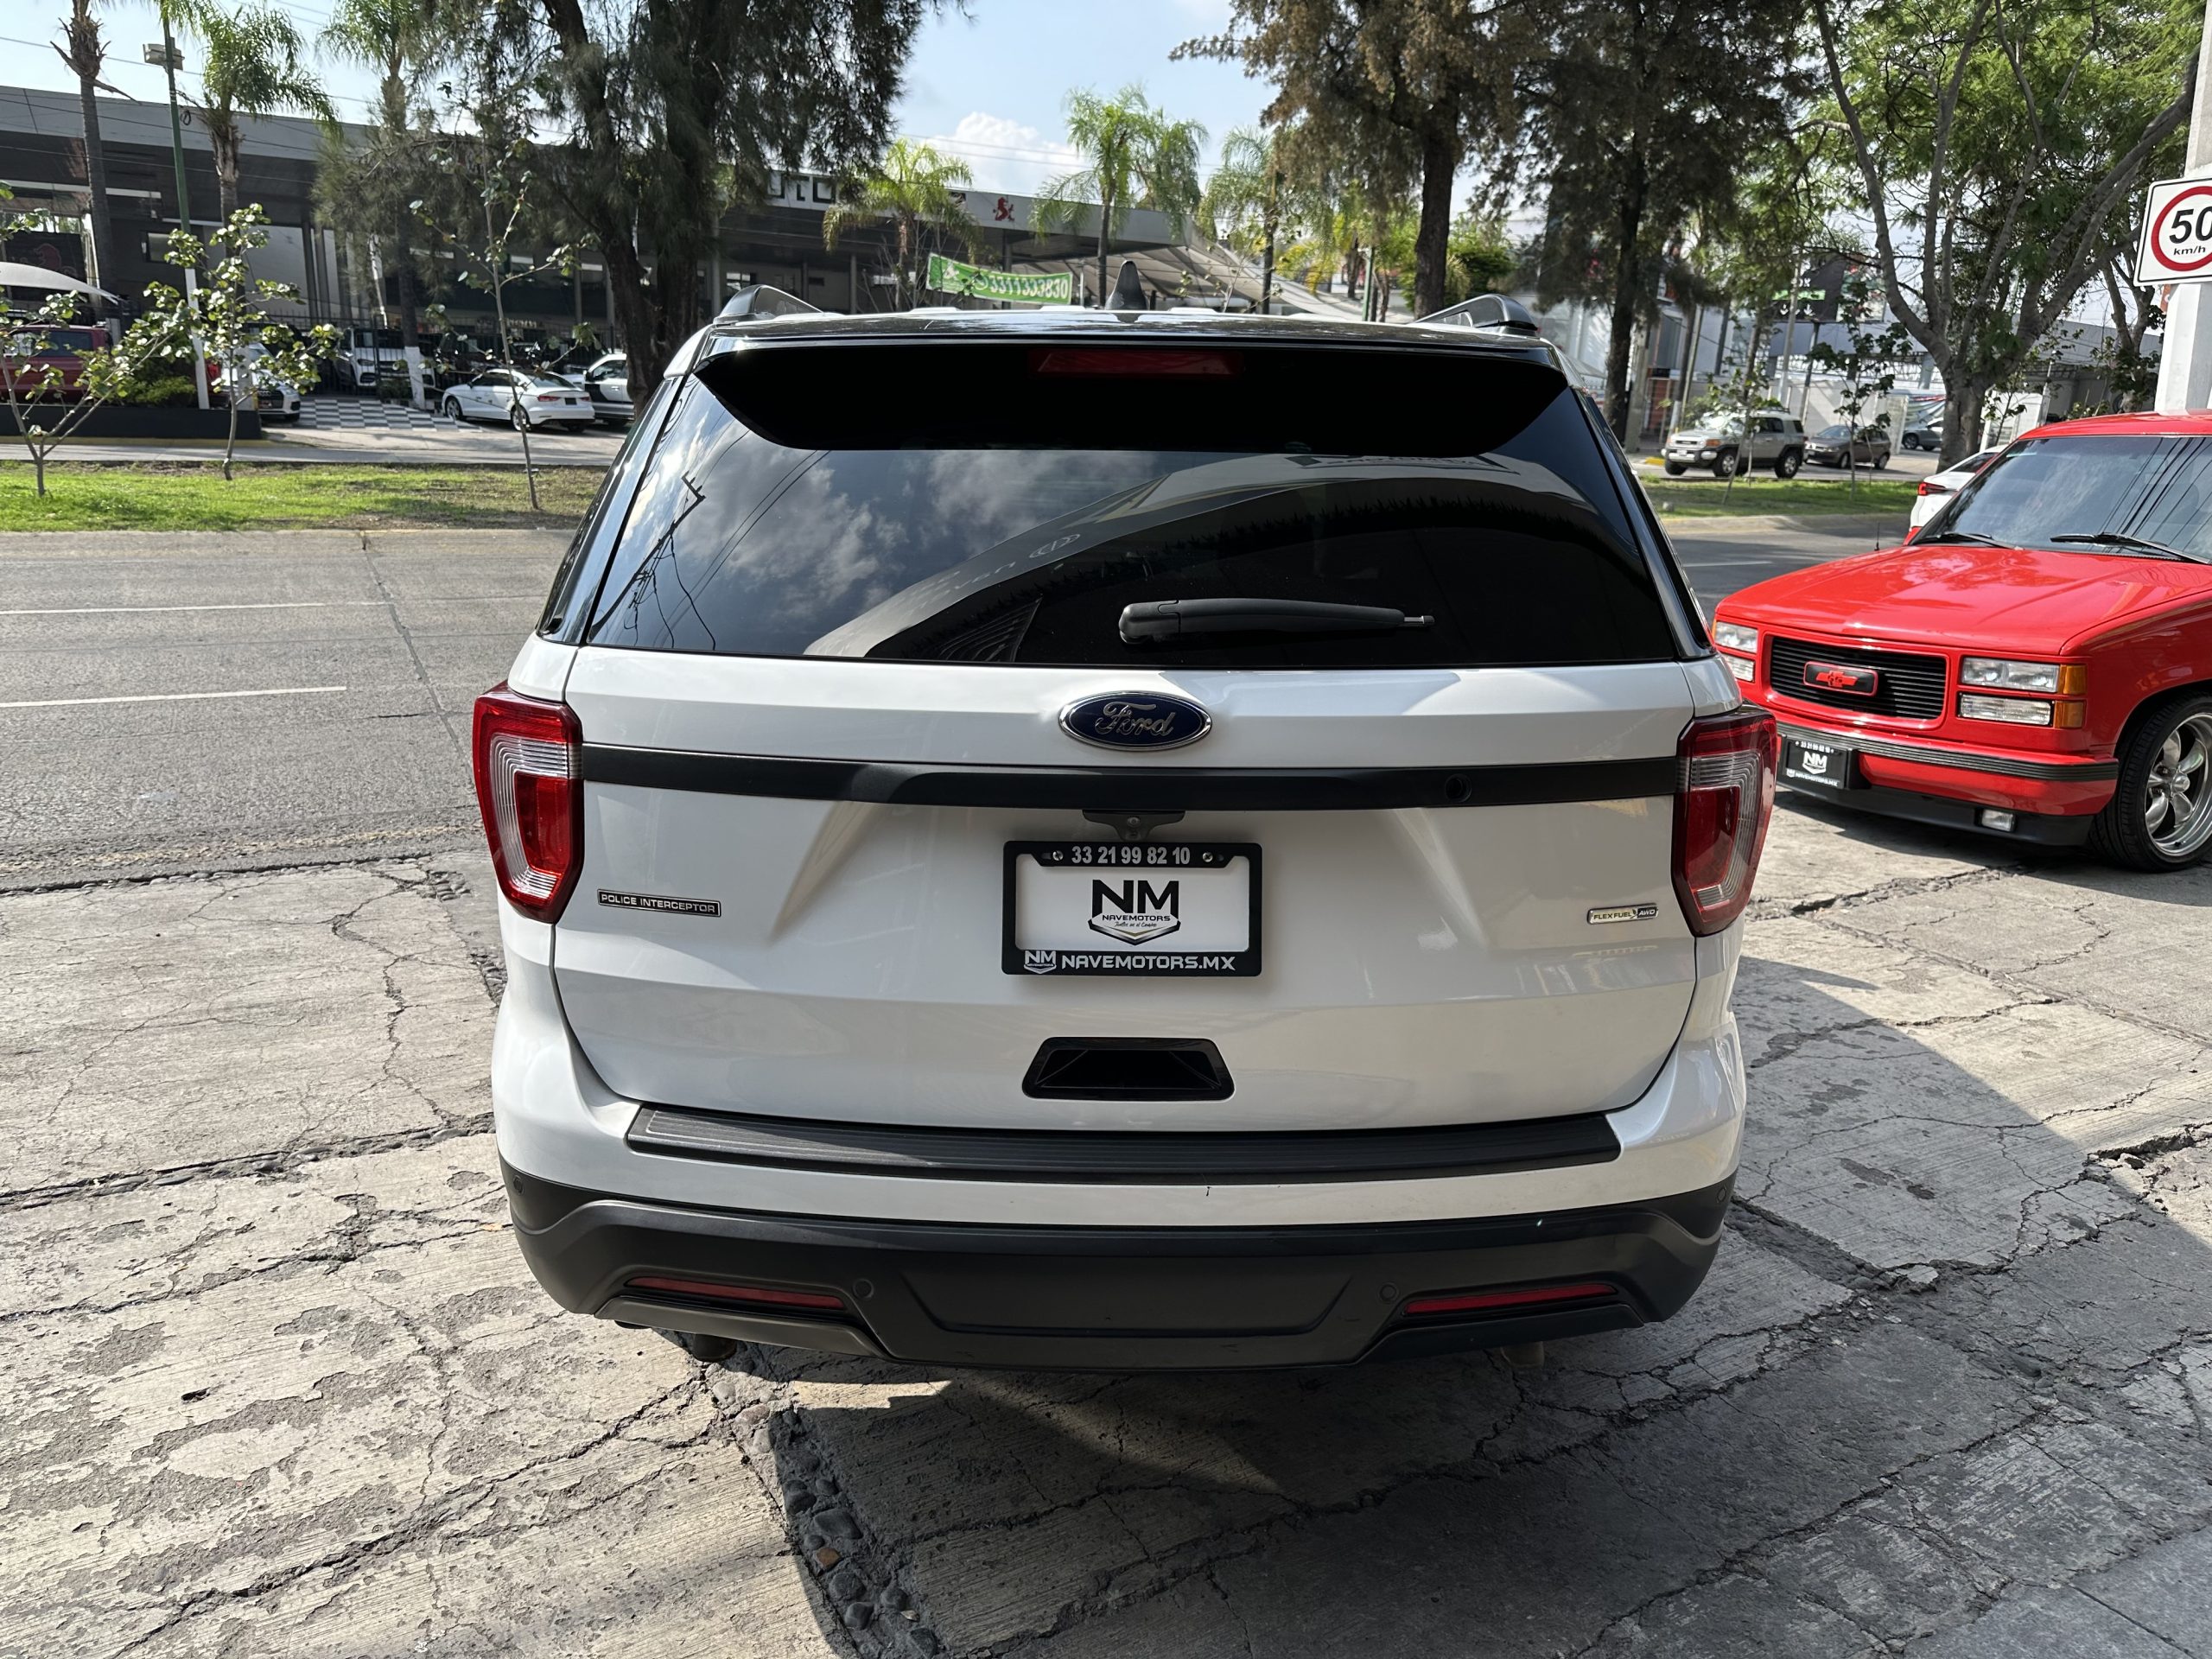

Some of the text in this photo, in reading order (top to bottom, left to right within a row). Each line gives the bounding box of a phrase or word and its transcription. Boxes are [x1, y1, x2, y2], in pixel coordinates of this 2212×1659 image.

[2169, 207, 2212, 244] 50
[2173, 245, 2206, 256] km/h
[1095, 701, 1176, 735] Ford
[1803, 751, 1827, 769] NM
[1071, 846, 1191, 865] 33 21 99 82 10
[601, 893, 715, 913] POLICE INTERCEPTOR
[1092, 879, 1179, 920] NM
[1025, 950, 1236, 971] NM NAVEMOTORS.MX
